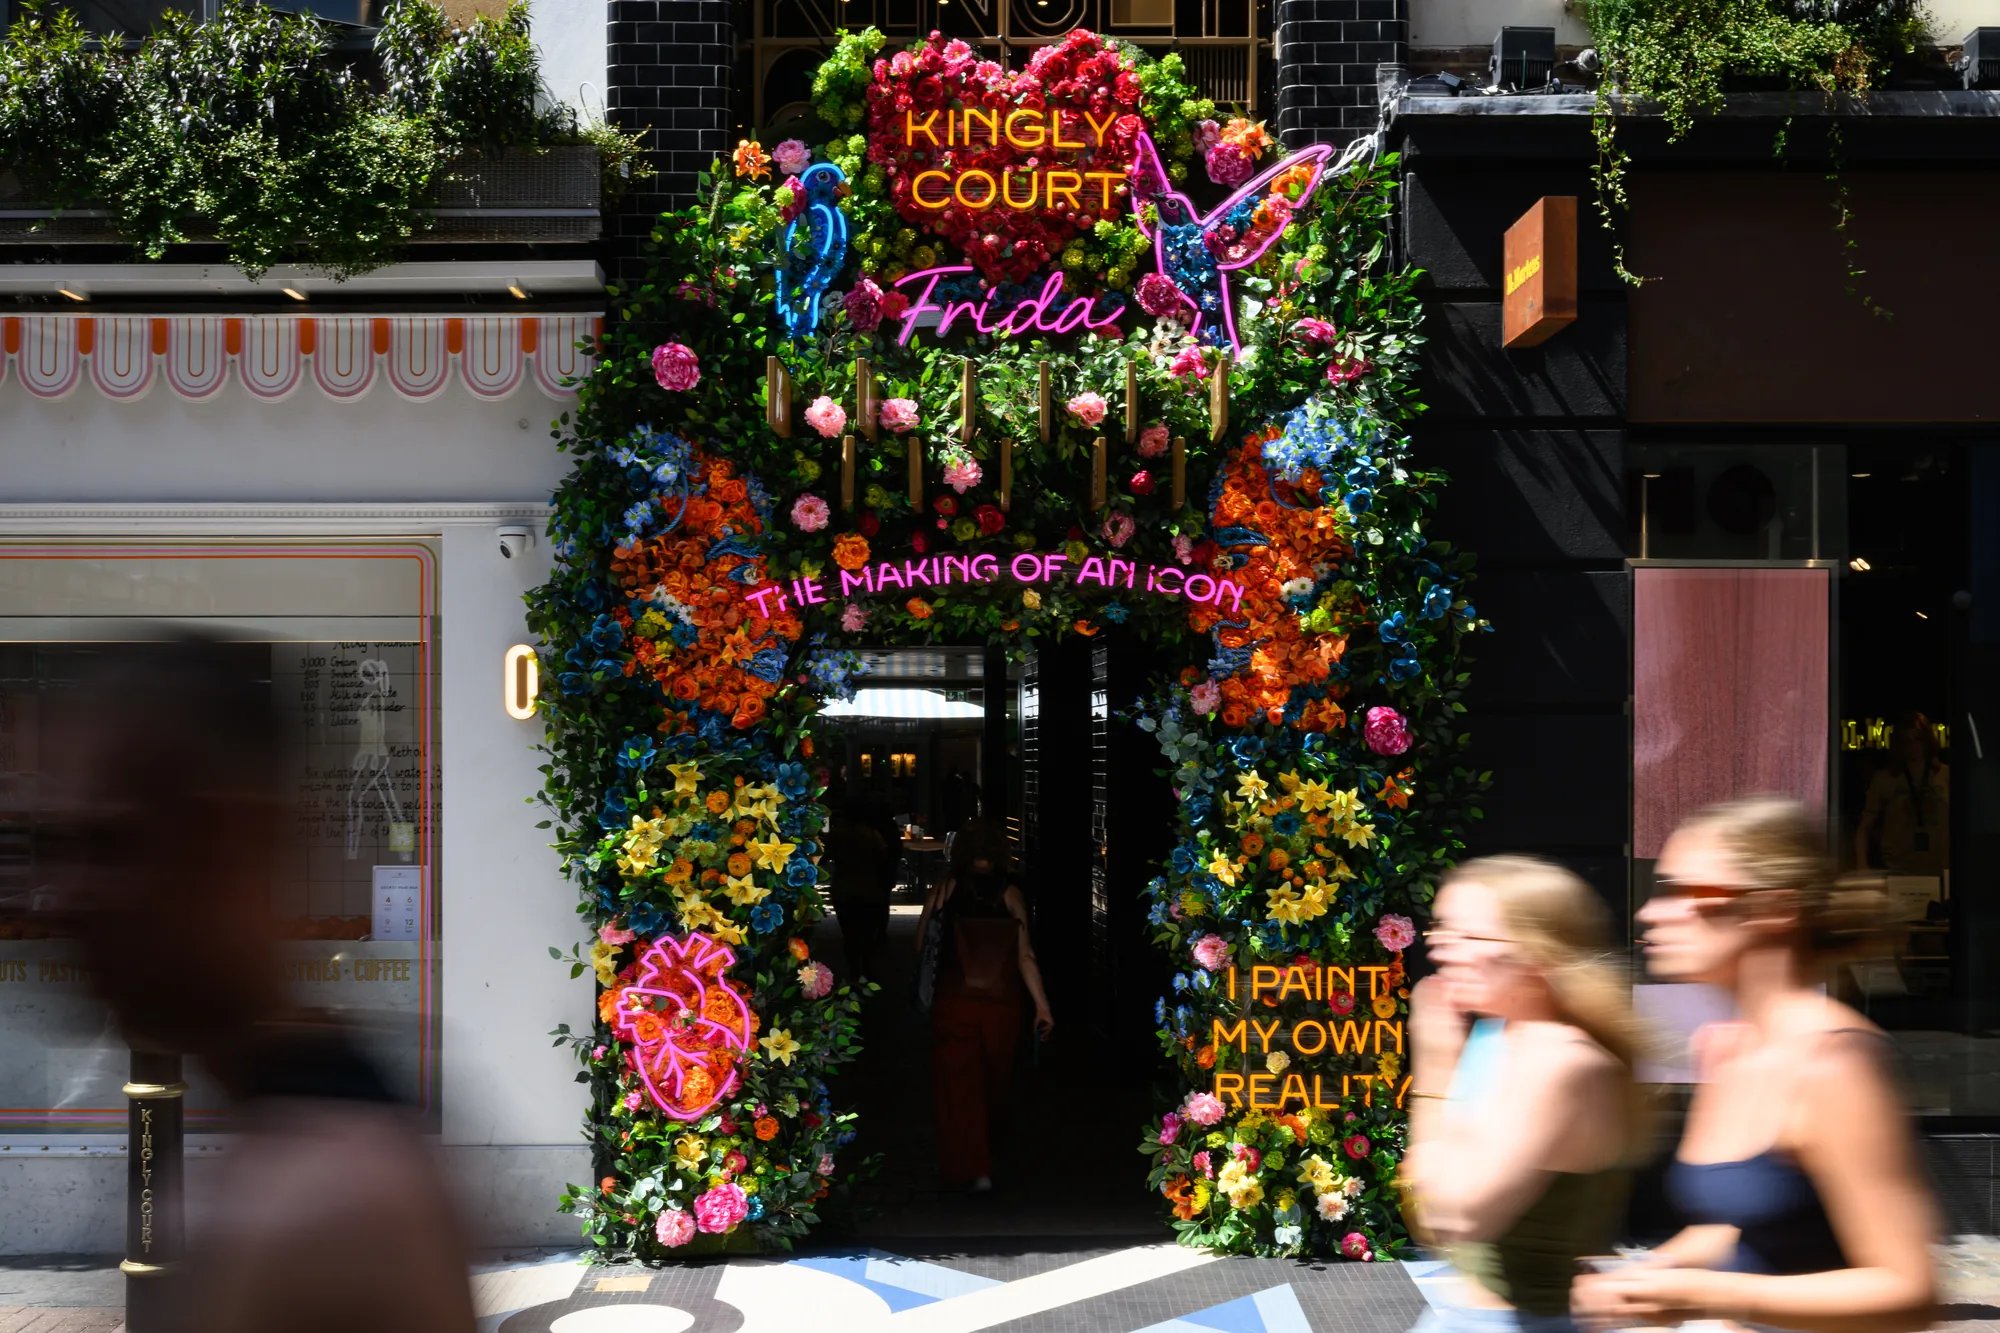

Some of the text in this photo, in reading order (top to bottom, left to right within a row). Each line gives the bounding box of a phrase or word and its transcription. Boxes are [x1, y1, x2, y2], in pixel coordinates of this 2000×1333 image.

[906, 109, 1118, 149] KINGLY
[912, 170, 1128, 212] COURT
[893, 265, 1125, 346] Frida
[745, 552, 1245, 618] THE MAKING OF AN ICON
[354, 959, 411, 982] COFFEE
[1227, 965, 1389, 1001] I PAINT
[1213, 1019, 1403, 1055] MY OWN
[1214, 1073, 1414, 1110] REALITY
[140, 1108, 153, 1254] KINGLY COURT
